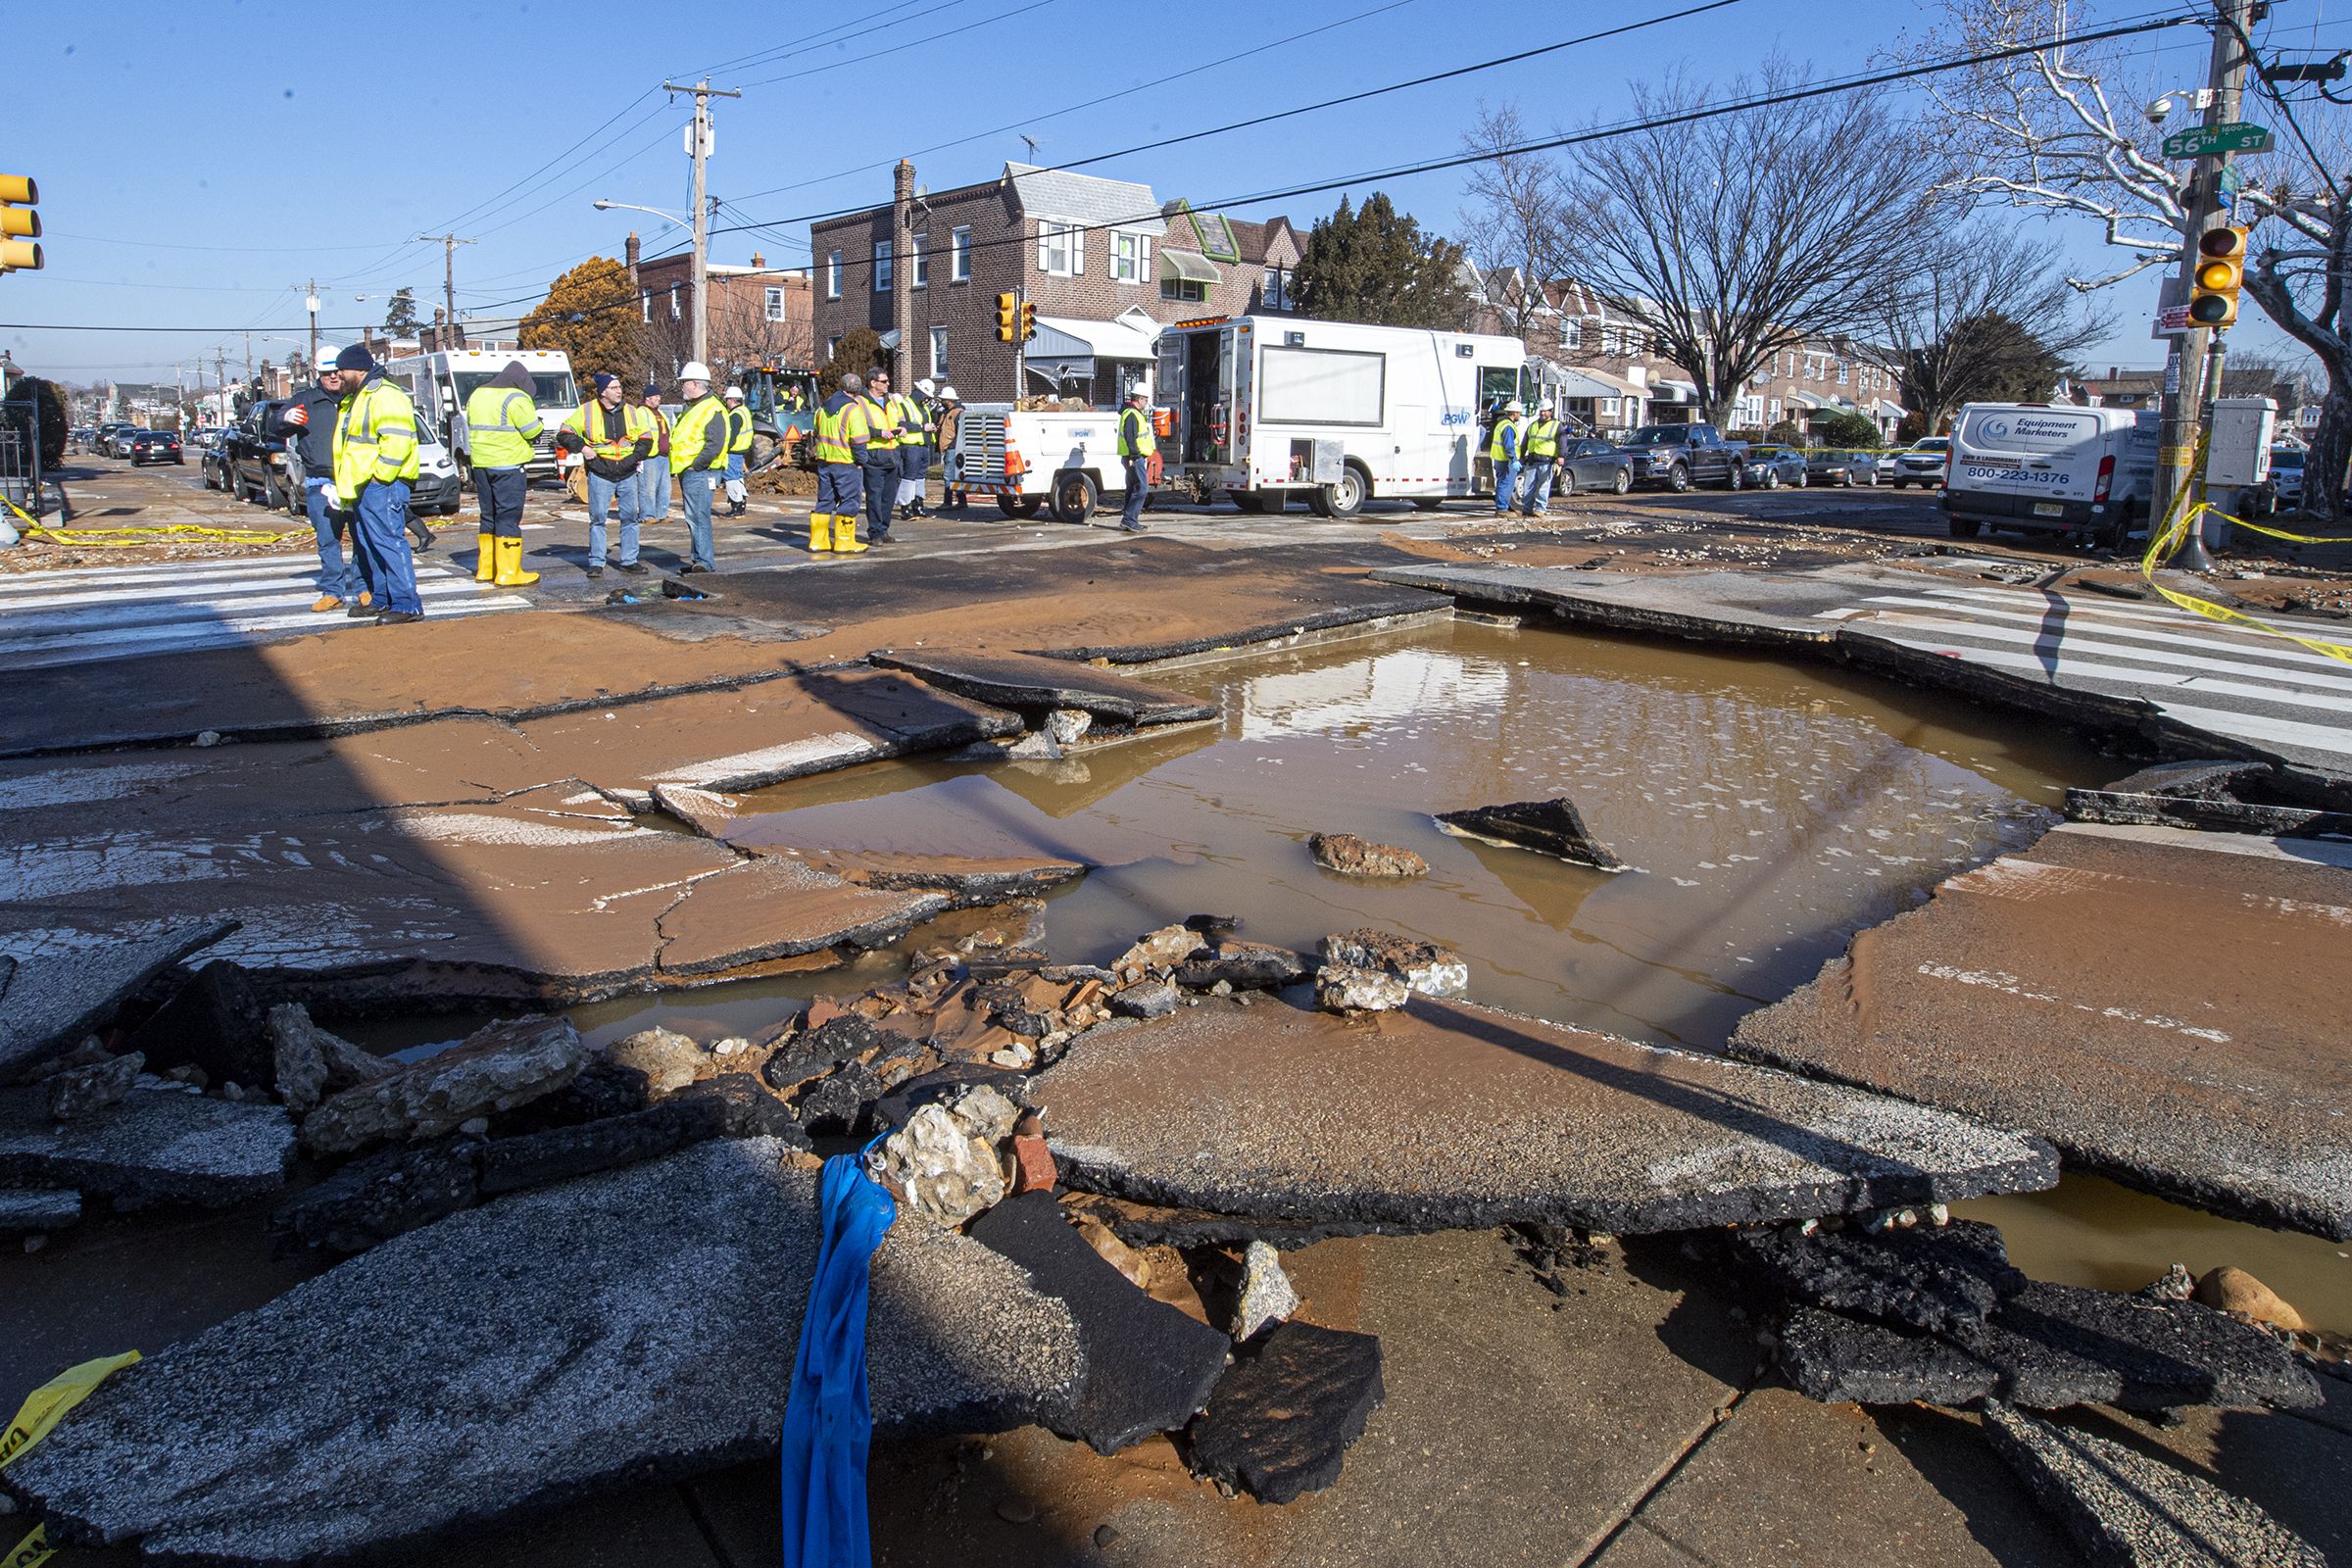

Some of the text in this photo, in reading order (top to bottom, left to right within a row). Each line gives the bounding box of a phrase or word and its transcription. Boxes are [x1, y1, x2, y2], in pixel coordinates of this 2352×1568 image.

[2222, 124, 2243, 133] 1600
[2168, 135, 2263, 155] 56TH ST
[1443, 412, 1469, 425] PGW
[2017, 417, 2078, 429] Equipment
[2014, 427, 2069, 438] Marketers
[1982, 456, 2022, 465] LAUNDROMAT
[1968, 466, 2070, 484] 800-223-1376
